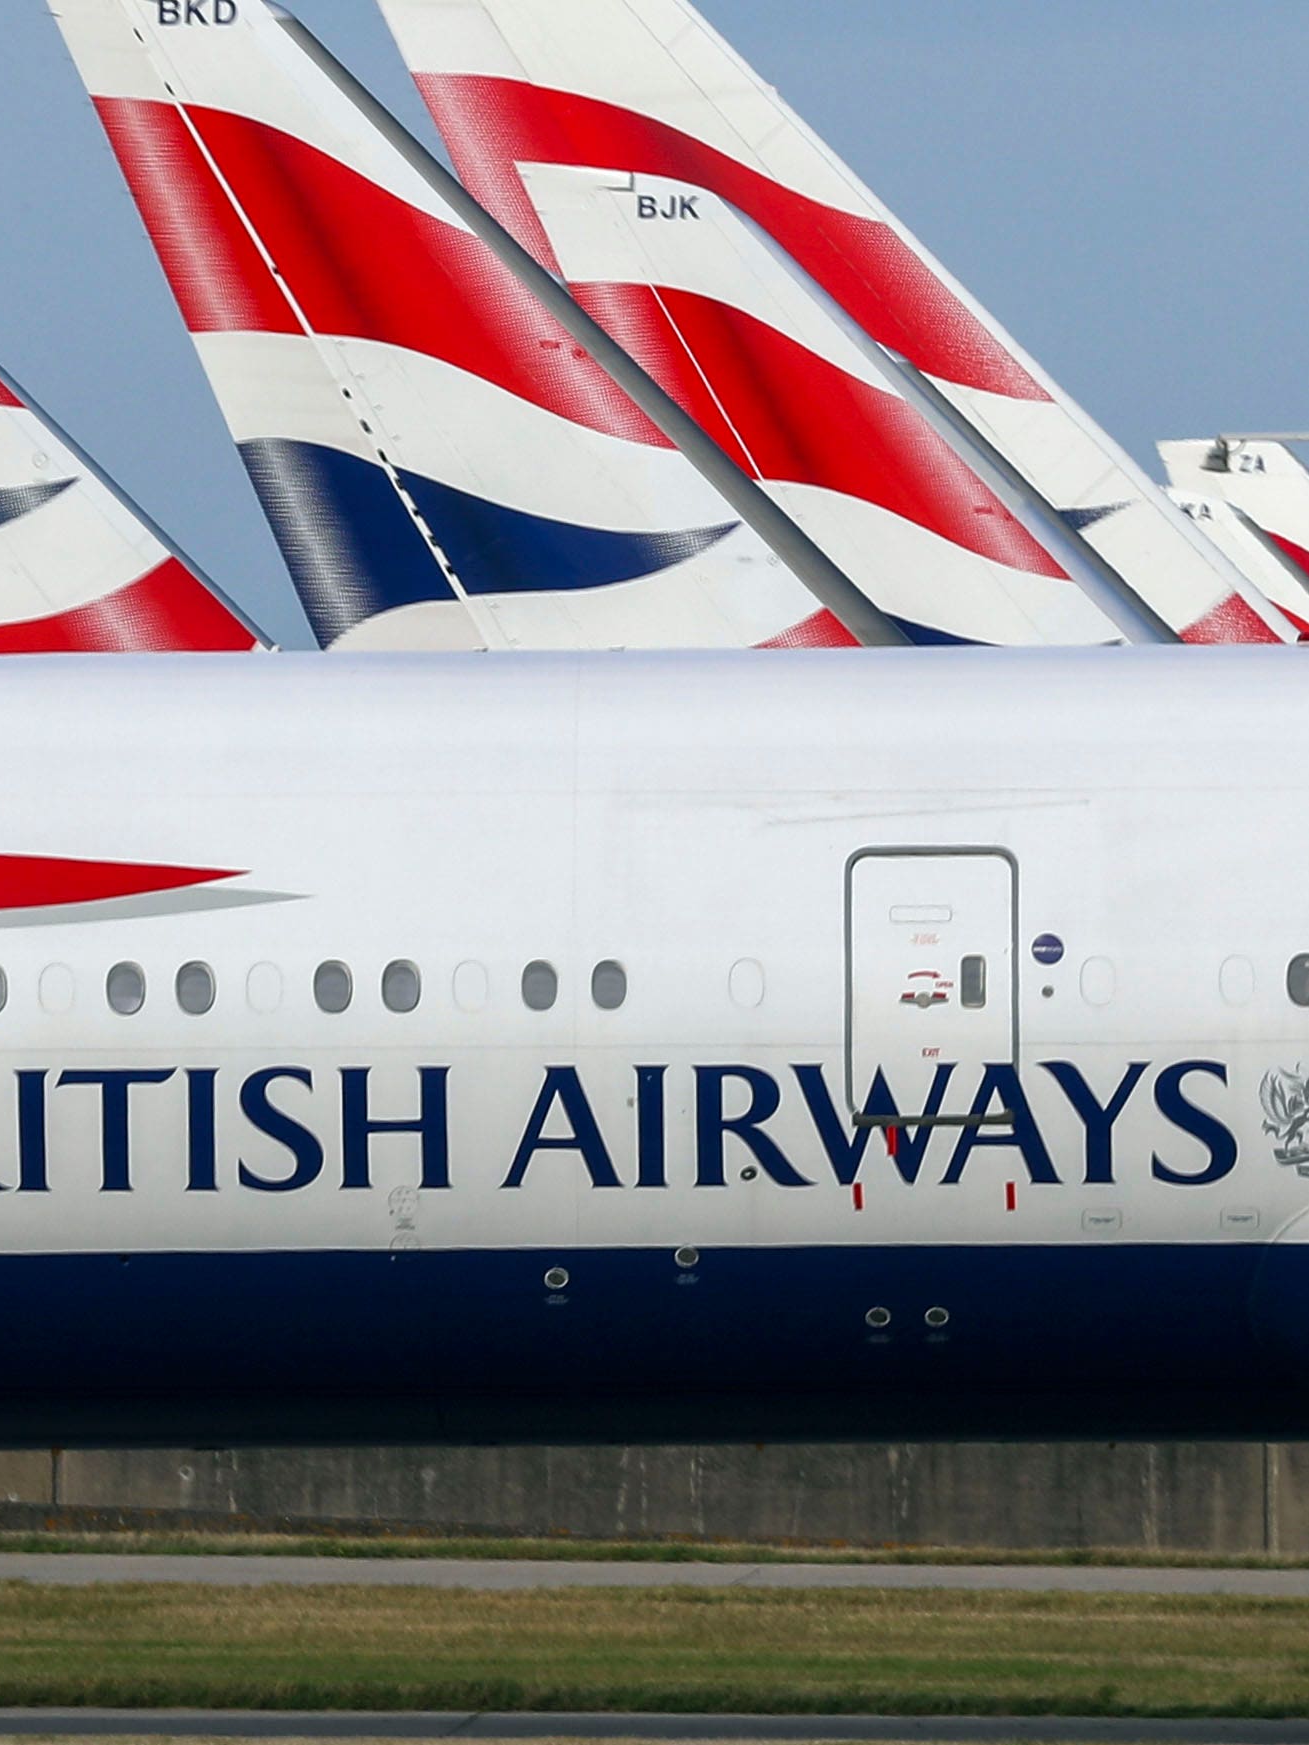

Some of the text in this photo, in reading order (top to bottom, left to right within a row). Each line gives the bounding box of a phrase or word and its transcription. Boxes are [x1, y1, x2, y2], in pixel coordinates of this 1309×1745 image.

[159, 0, 237, 25] BKD
[638, 195, 701, 220] BJK
[922, 1047, 940, 1057] EXIT
[498, 1060, 1238, 1189] AIRWAYS
